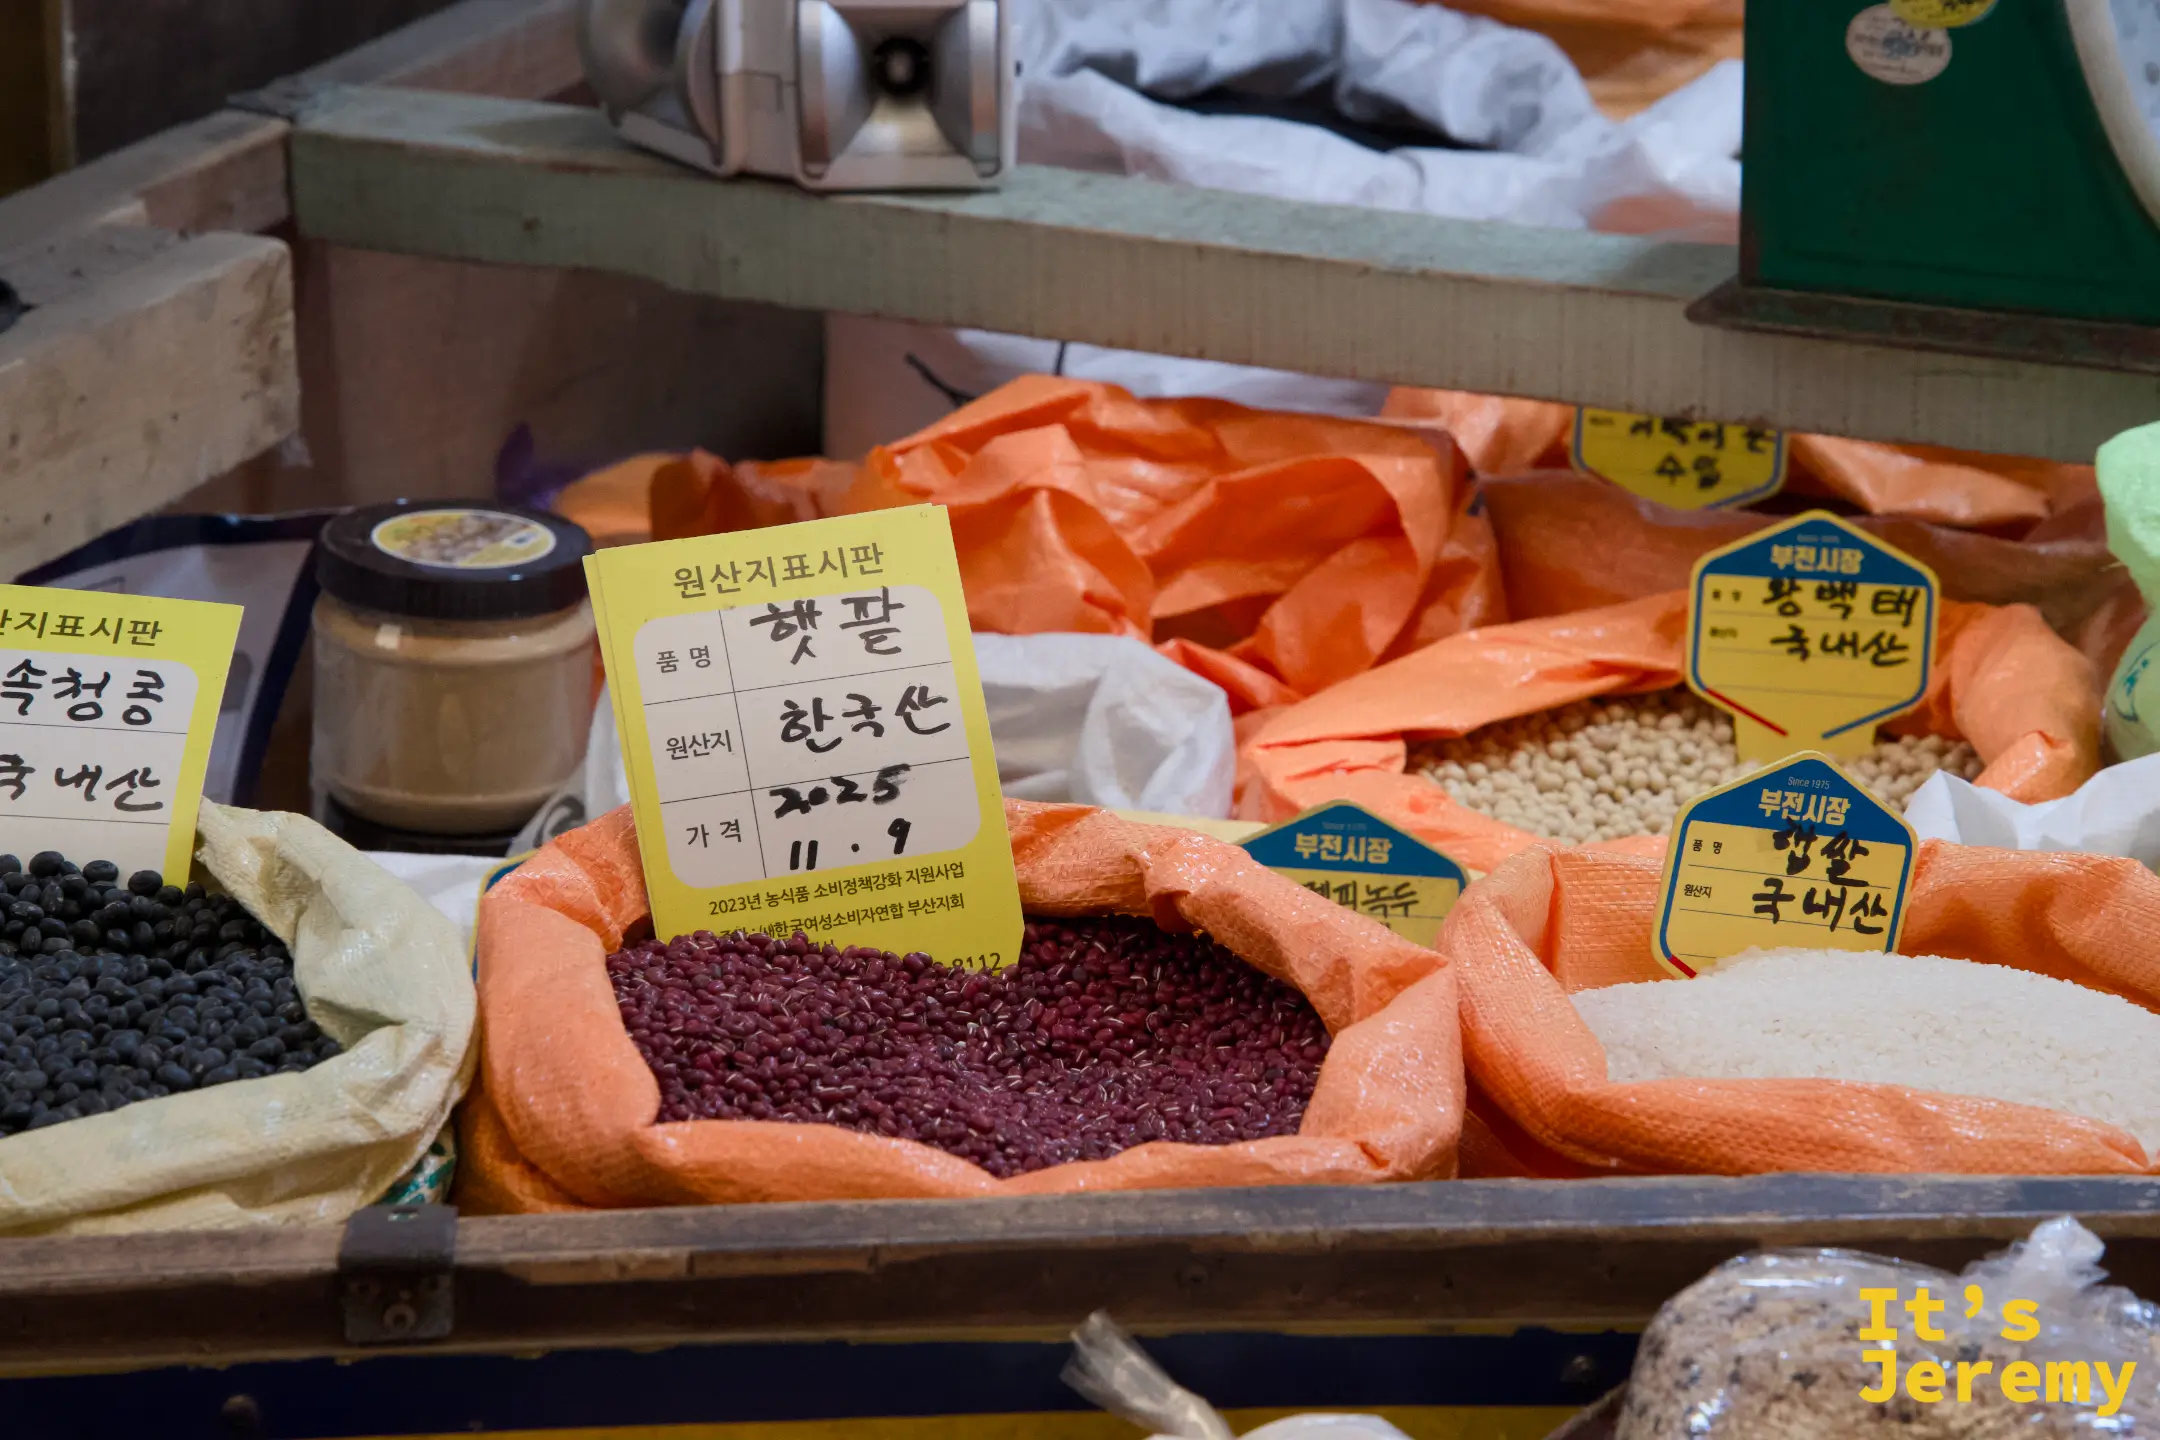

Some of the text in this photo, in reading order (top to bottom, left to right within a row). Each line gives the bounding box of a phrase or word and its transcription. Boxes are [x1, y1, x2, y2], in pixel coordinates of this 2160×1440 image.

[673, 542, 884, 599] 원산지표시판
[1770, 544, 1865, 575] 부전시장
[1770, 624, 1909, 667] 국내산
[780, 685, 951, 753] 한국산
[666, 730, 733, 760] 원산지
[769, 763, 911, 819] 2025
[1787, 776, 1830, 790] Since 1975
[1757, 788, 1851, 826] 부전시장
[1294, 832, 1393, 865] 부전시장
[709, 861, 965, 915] 2023년 농식품 소비정책강화 지원사업
[907, 893, 965, 916] 부산지회
[1683, 883, 1712, 899] 원산지
[1752, 877, 1888, 934] 국내산
